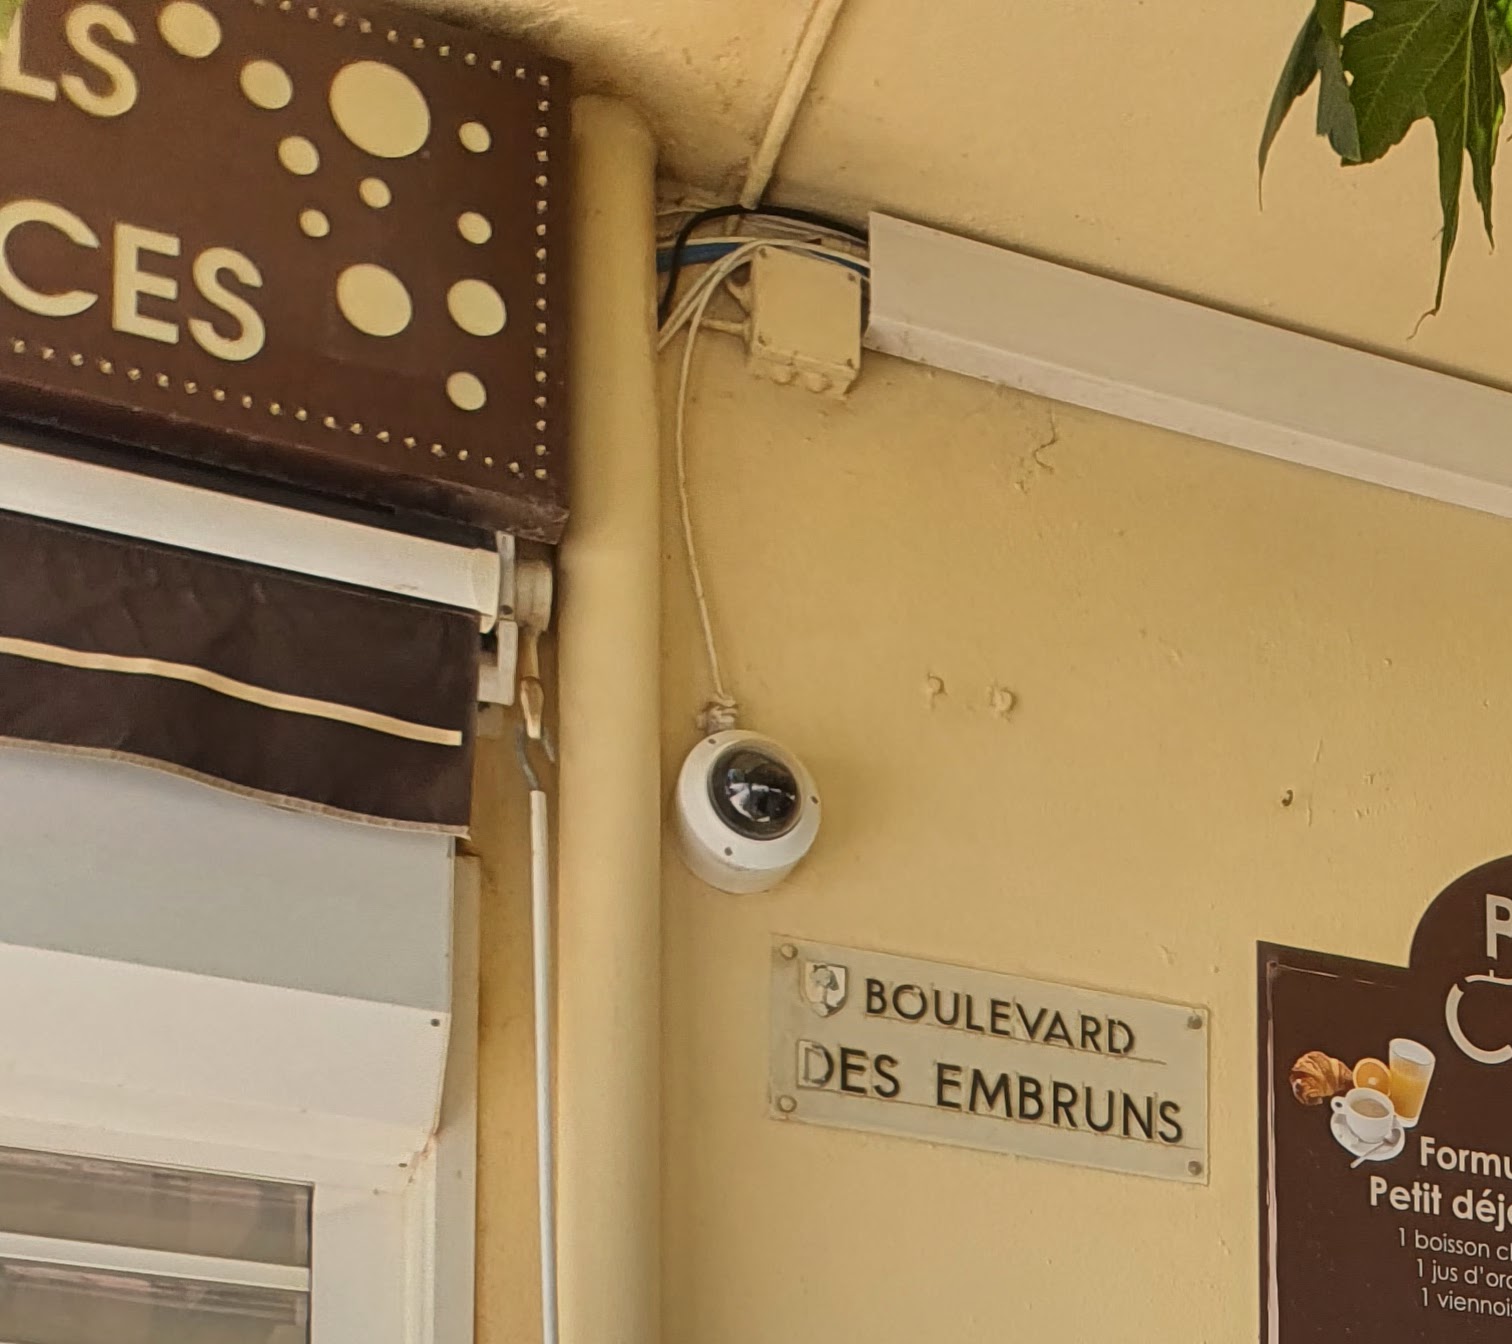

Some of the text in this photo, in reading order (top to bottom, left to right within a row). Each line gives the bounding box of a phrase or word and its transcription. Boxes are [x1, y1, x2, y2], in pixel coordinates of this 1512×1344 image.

[0, 0, 137, 117] LS
[0, 199, 266, 361] CES
[865, 977, 1137, 1056] BOULEVARD
[797, 1039, 1185, 1144] DES EMBRUNS
[1369, 1175, 1442, 1216] Petit
[1398, 1227, 1406, 1247] 1
[1414, 1229, 1491, 1259] boisson
[1416, 1258, 1424, 1278] 1
[1431, 1259, 1459, 1285] jus
[1421, 1287, 1429, 1307] 1
